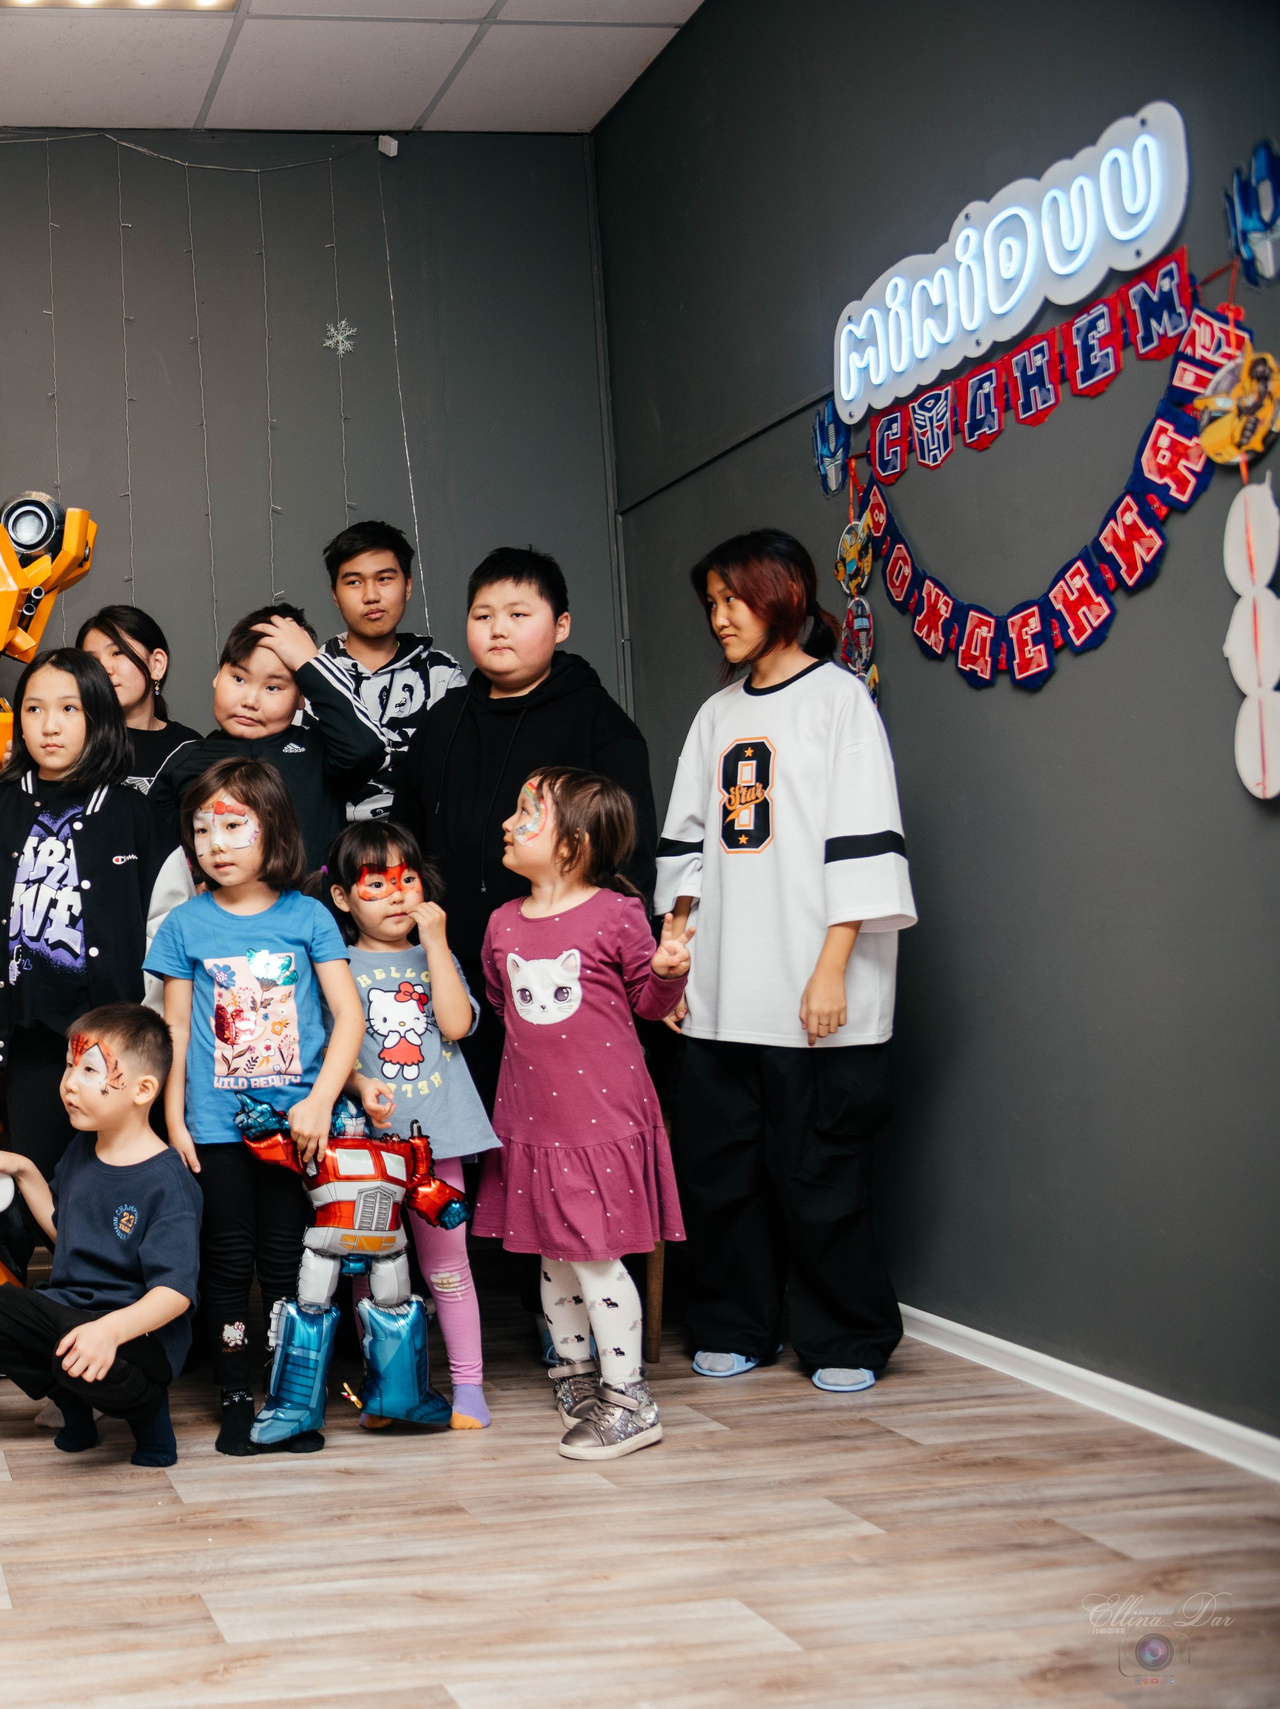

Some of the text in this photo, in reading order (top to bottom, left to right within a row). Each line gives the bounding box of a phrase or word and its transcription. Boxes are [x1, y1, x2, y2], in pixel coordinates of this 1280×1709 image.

[964, 260, 1188, 444] ДНЕМ
[868, 417, 1209, 681] РОЖДЕНИЯ
[725, 782, 766, 811] Star
[213, 1073, 301, 1090] WILD BEAUTY
